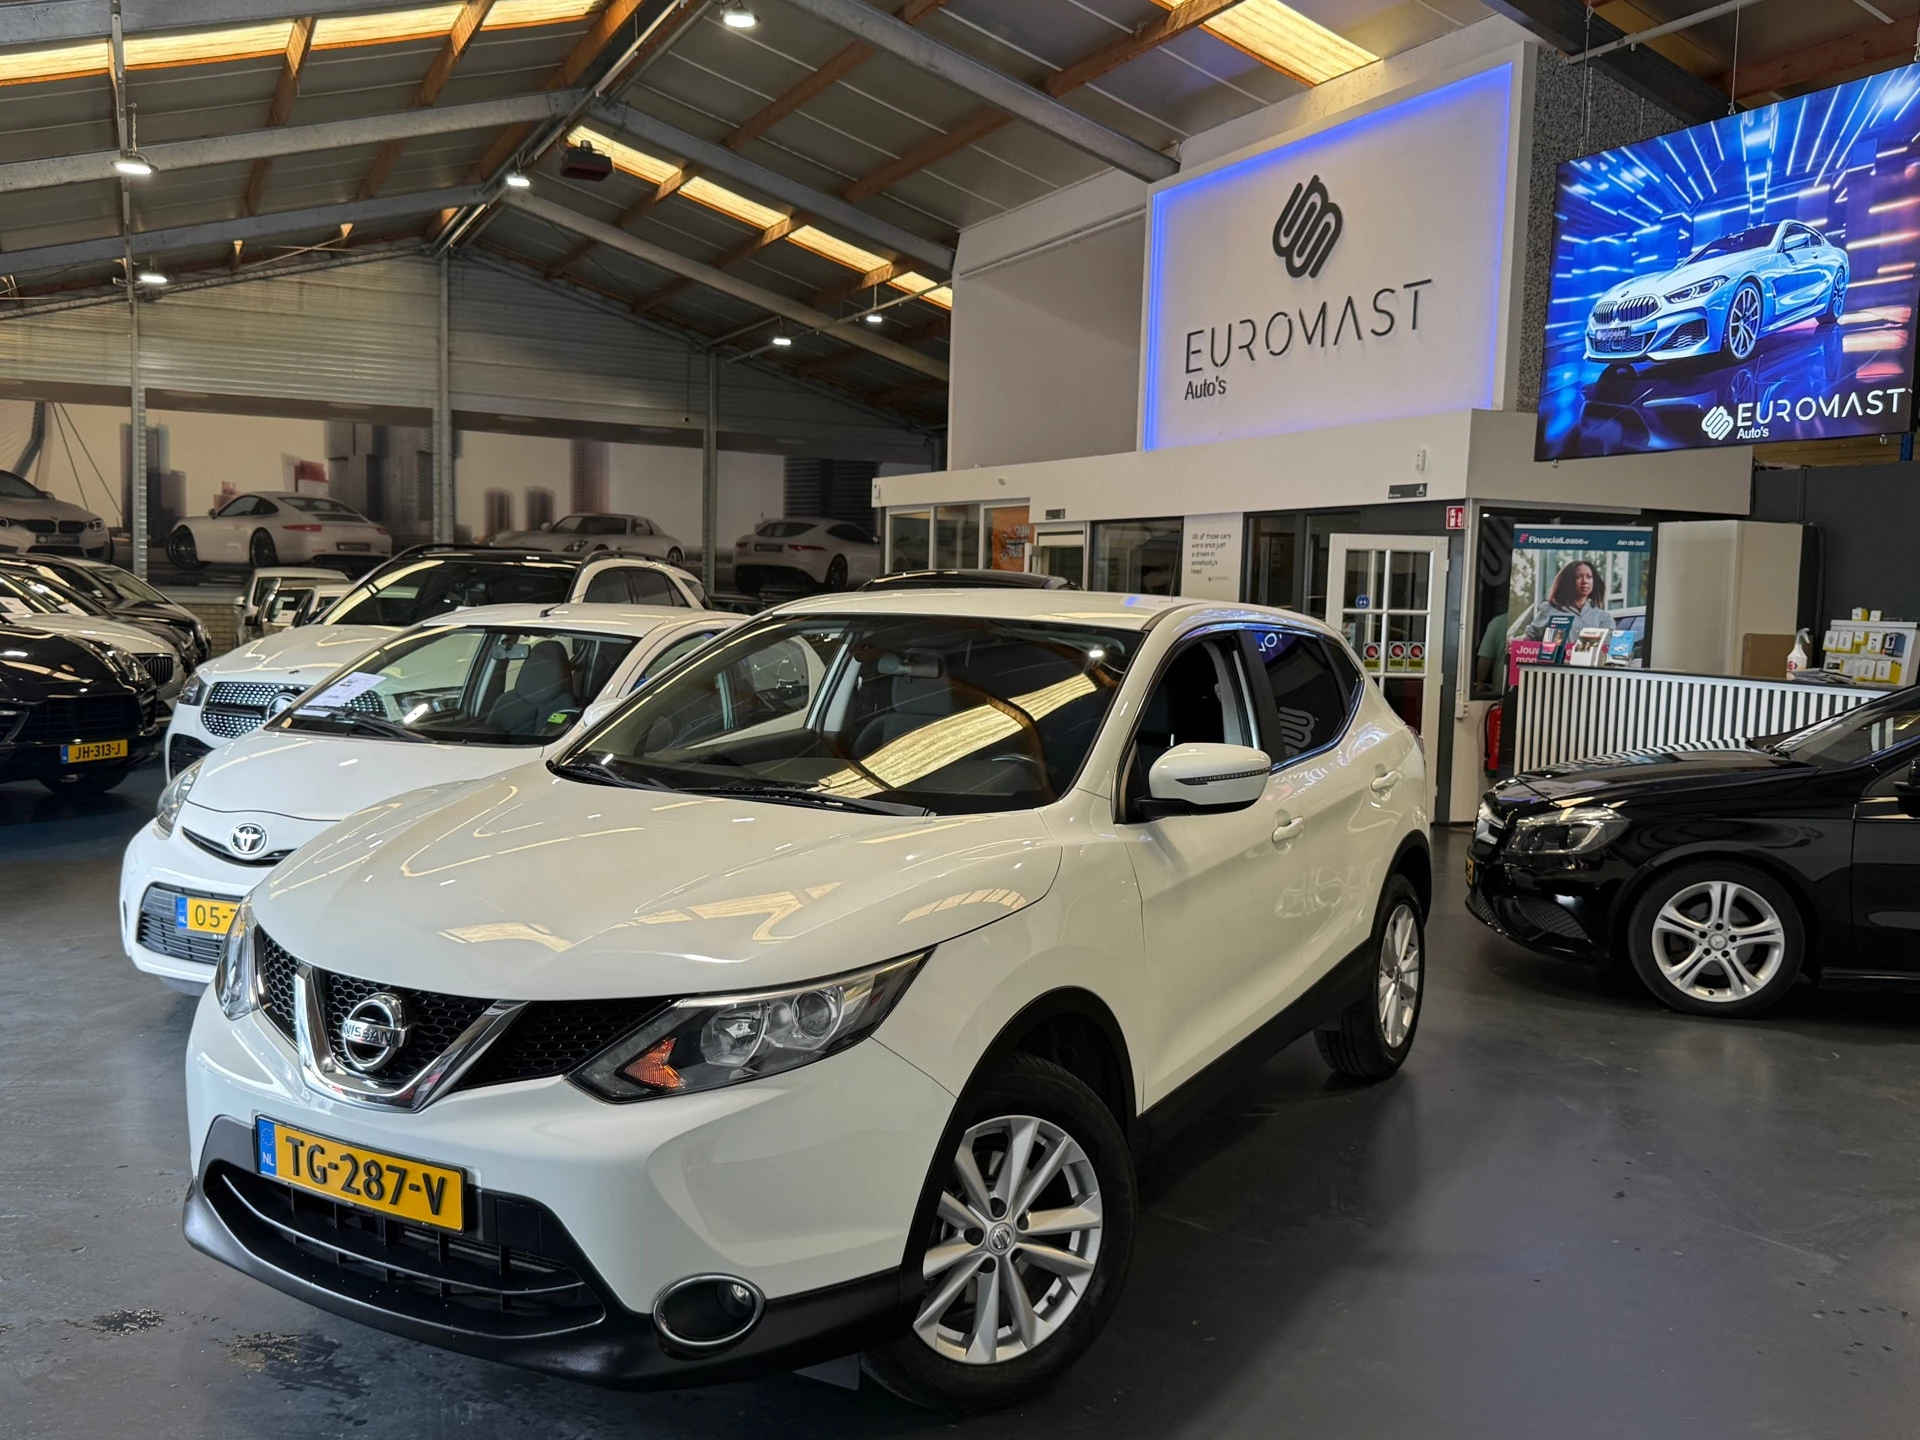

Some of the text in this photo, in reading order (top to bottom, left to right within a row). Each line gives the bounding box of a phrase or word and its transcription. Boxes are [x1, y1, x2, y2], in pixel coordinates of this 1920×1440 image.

[1185, 278, 1432, 374] EUROMAST
[1184, 376, 1227, 401] Auto's
[1736, 387, 1906, 428] EUROMAST
[1736, 426, 1770, 440] Auto's
[75, 743, 121, 760] JH-313-J
[343, 1022, 396, 1047] NISSAN
[262, 1151, 275, 1167] NL
[285, 1135, 446, 1216] TG-287-V
